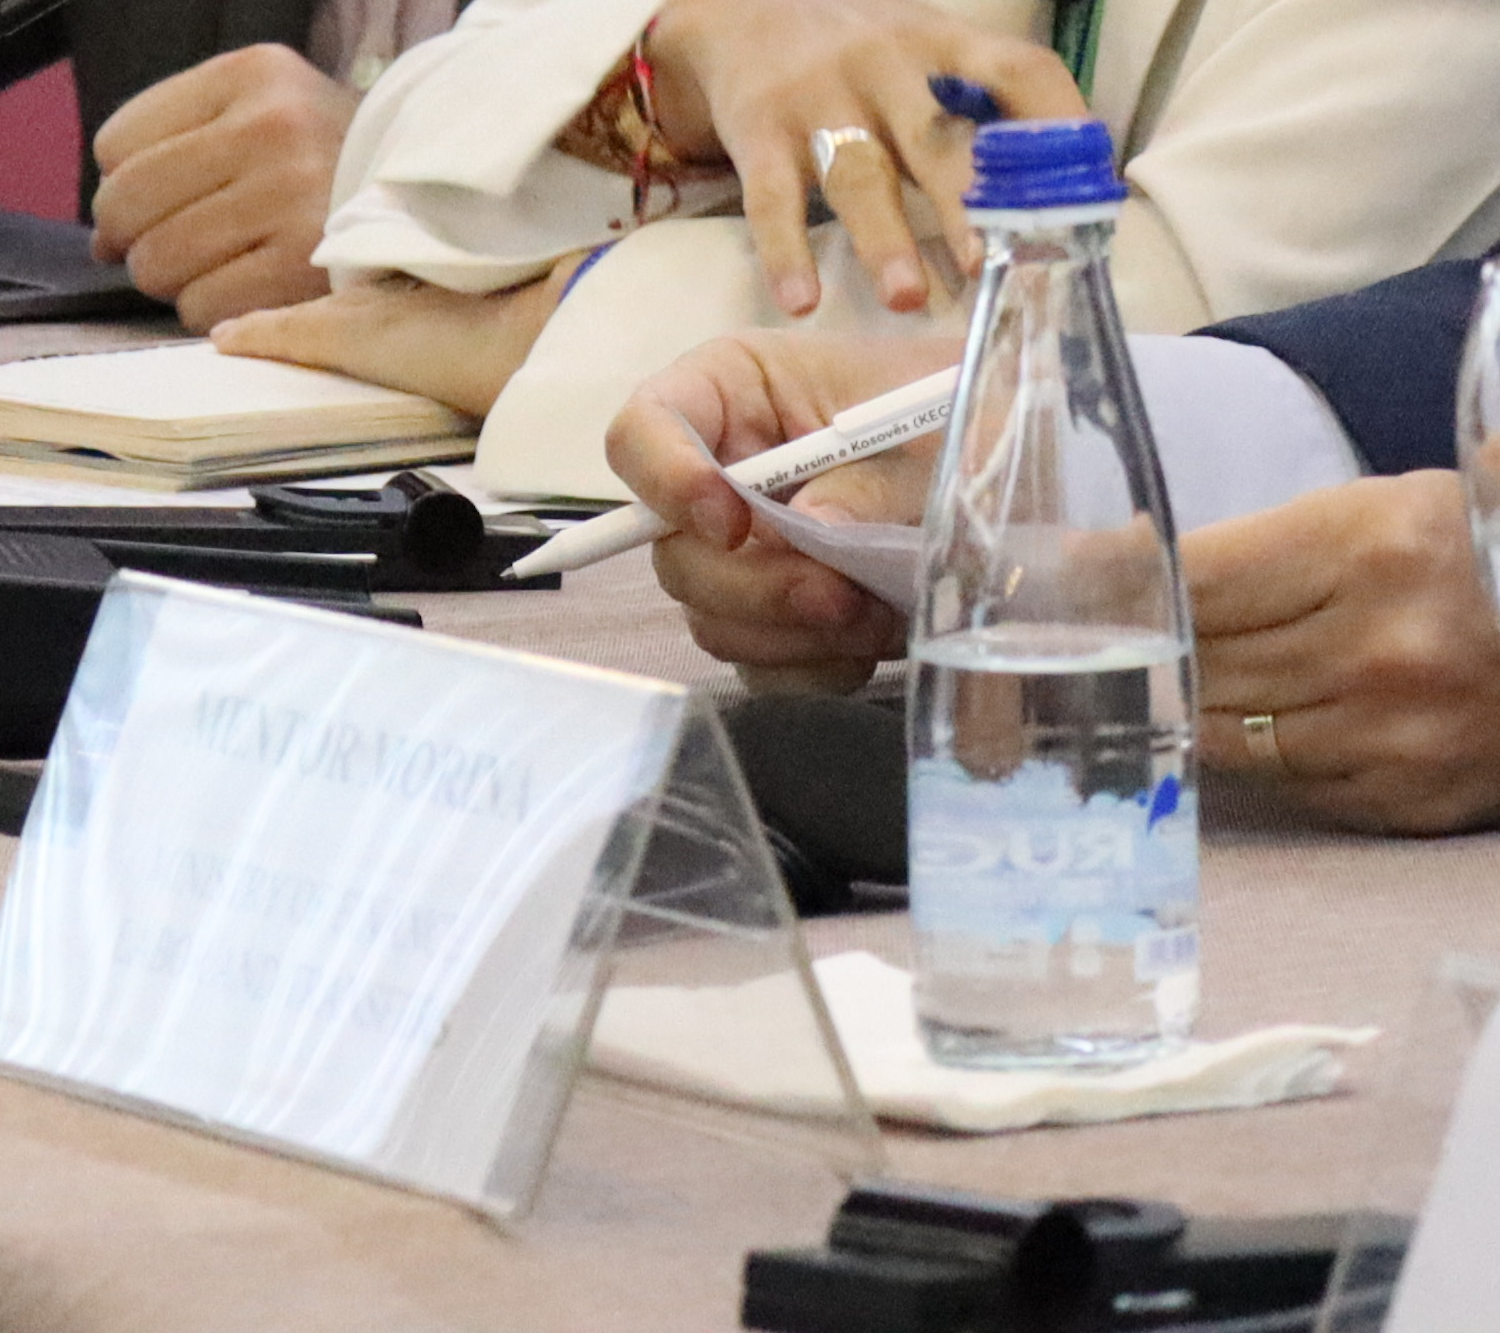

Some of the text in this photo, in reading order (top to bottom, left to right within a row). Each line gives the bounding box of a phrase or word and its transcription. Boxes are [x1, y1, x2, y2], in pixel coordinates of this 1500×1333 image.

[794, 453, 837, 476] Arsim
[839, 448, 847, 458] e
[850, 423, 910, 452] Kosovës
